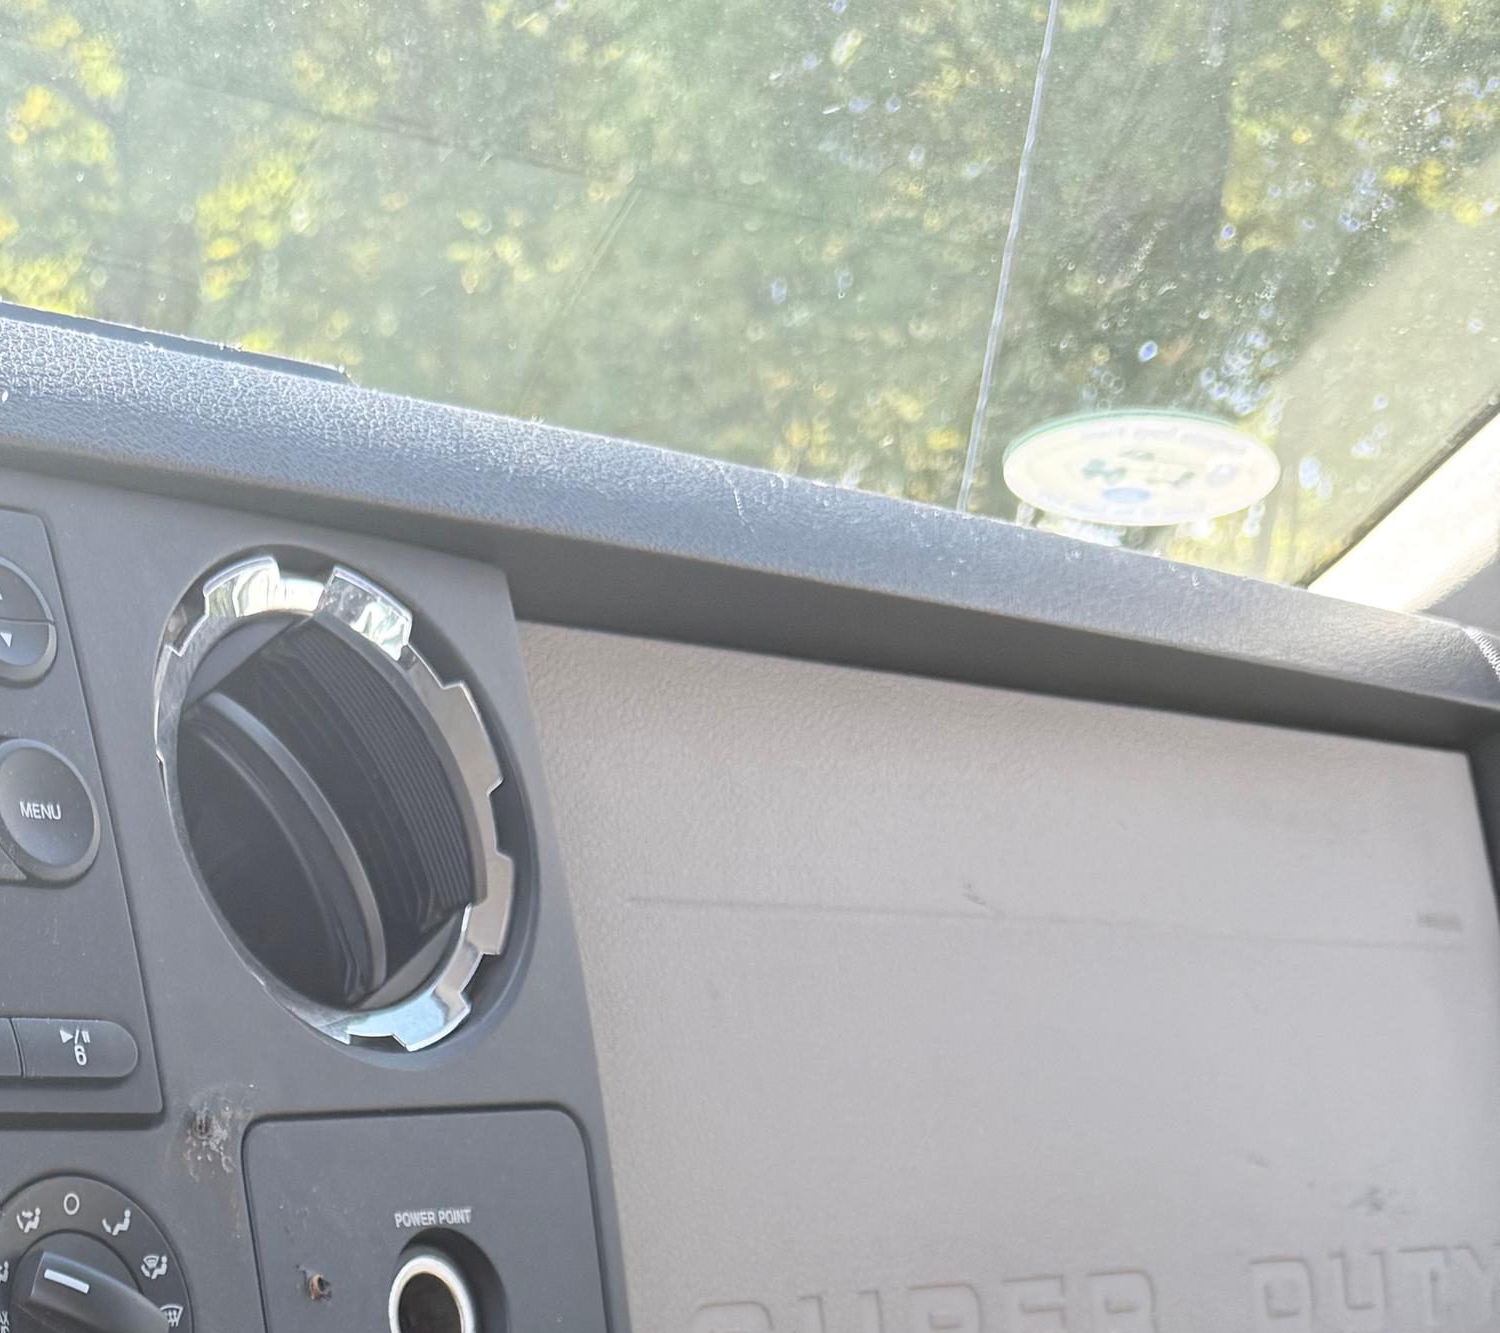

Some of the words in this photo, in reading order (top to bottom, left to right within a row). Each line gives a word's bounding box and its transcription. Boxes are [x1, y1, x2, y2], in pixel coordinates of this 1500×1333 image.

[20, 801, 61, 820] MENU
[74, 1044, 87, 1066] 6
[394, 1210, 436, 1228] POWER
[438, 1208, 472, 1225] POINT
